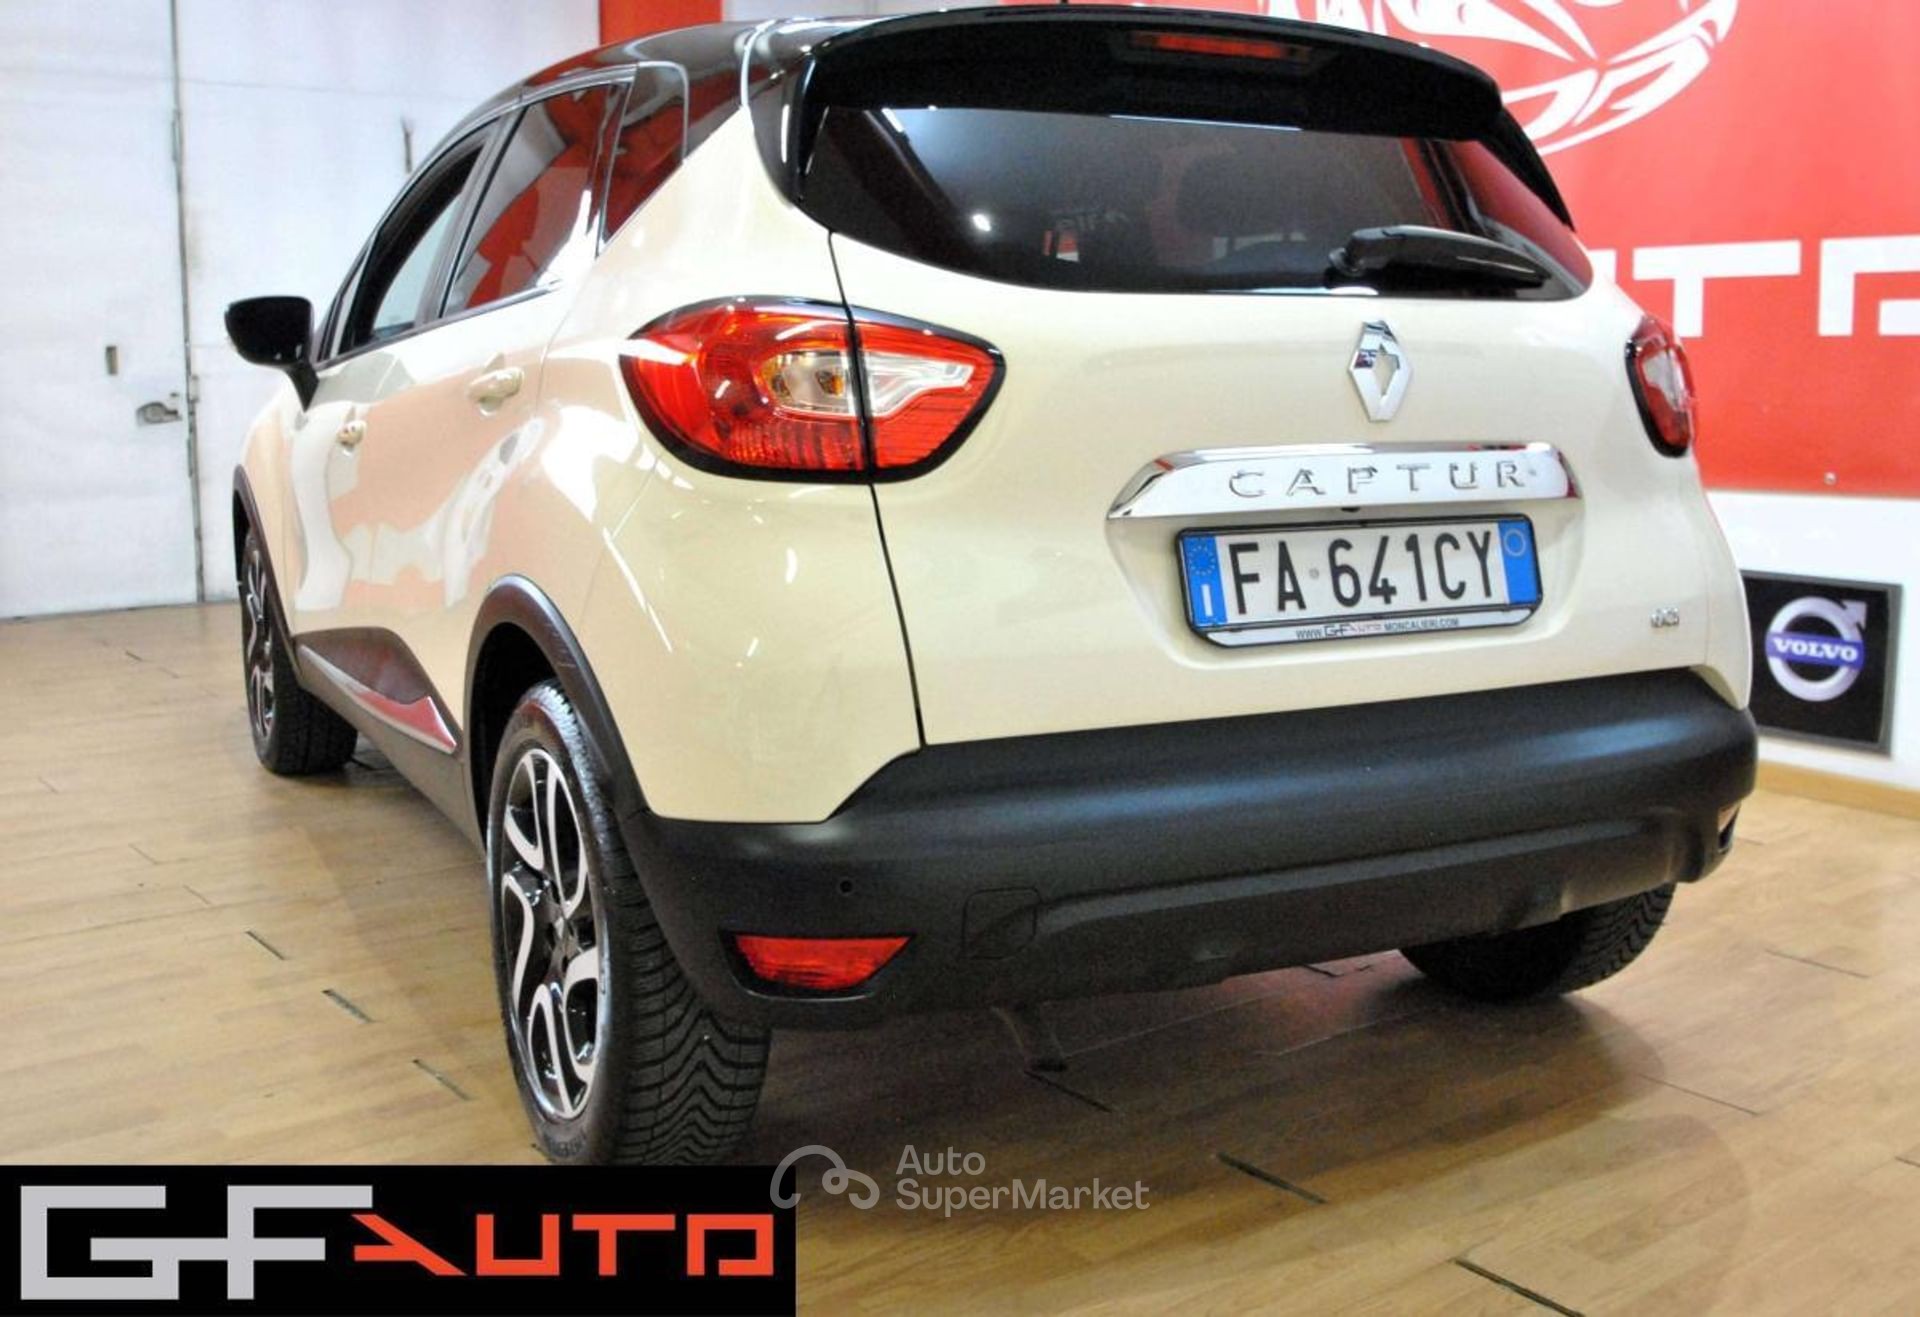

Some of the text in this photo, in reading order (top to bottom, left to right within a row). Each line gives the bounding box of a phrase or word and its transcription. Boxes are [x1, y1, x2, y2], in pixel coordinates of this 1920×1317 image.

[1228, 460, 1525, 498] CAPTUR
[1228, 540, 1307, 615] FA
[1328, 530, 1492, 608] 641CY
[1773, 636, 1858, 662] VOLVO
